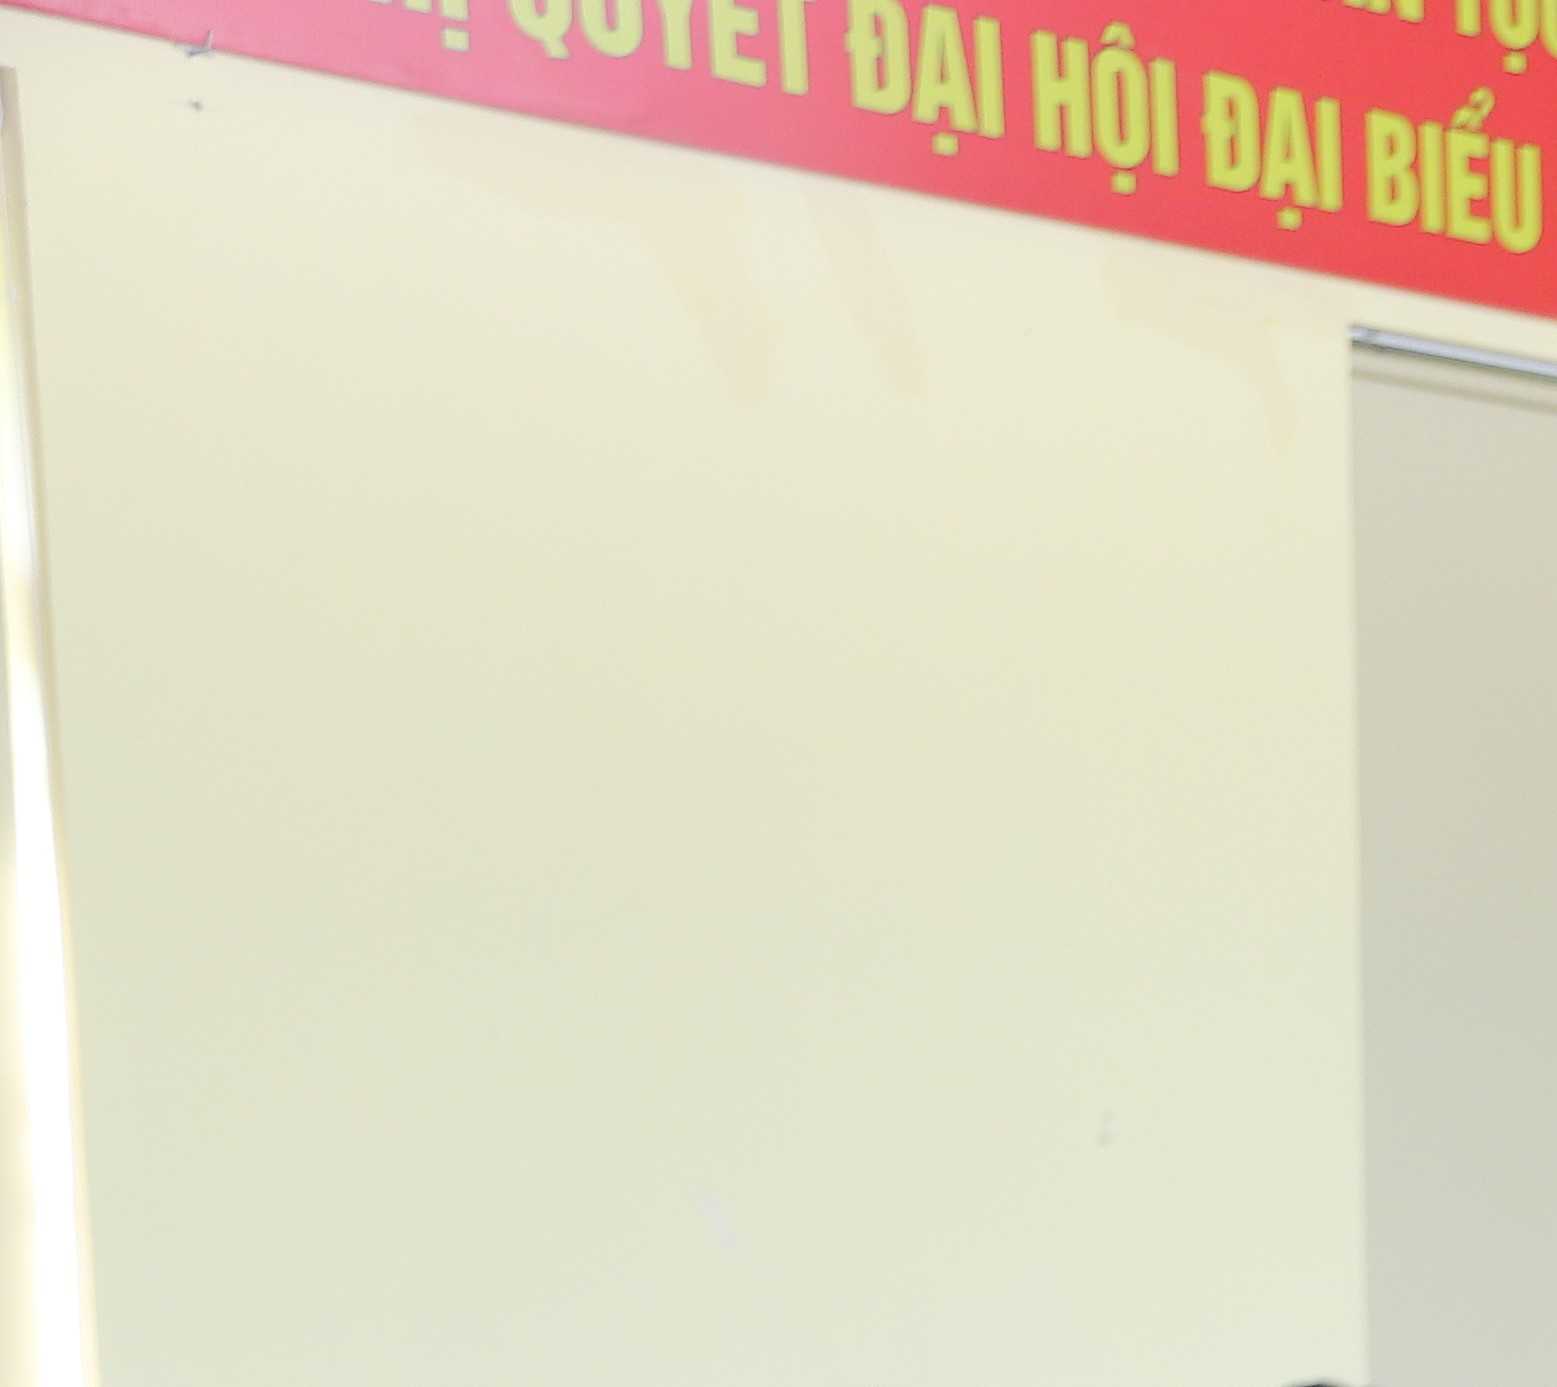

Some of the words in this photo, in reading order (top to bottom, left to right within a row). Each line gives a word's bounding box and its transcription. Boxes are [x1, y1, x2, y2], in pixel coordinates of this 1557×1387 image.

[846, 0, 1004, 155] ĐẠI
[1030, 20, 1179, 195] HỘI
[1202, 70, 1341, 230] ĐẠI
[1365, 87, 1543, 254] BIỂU
